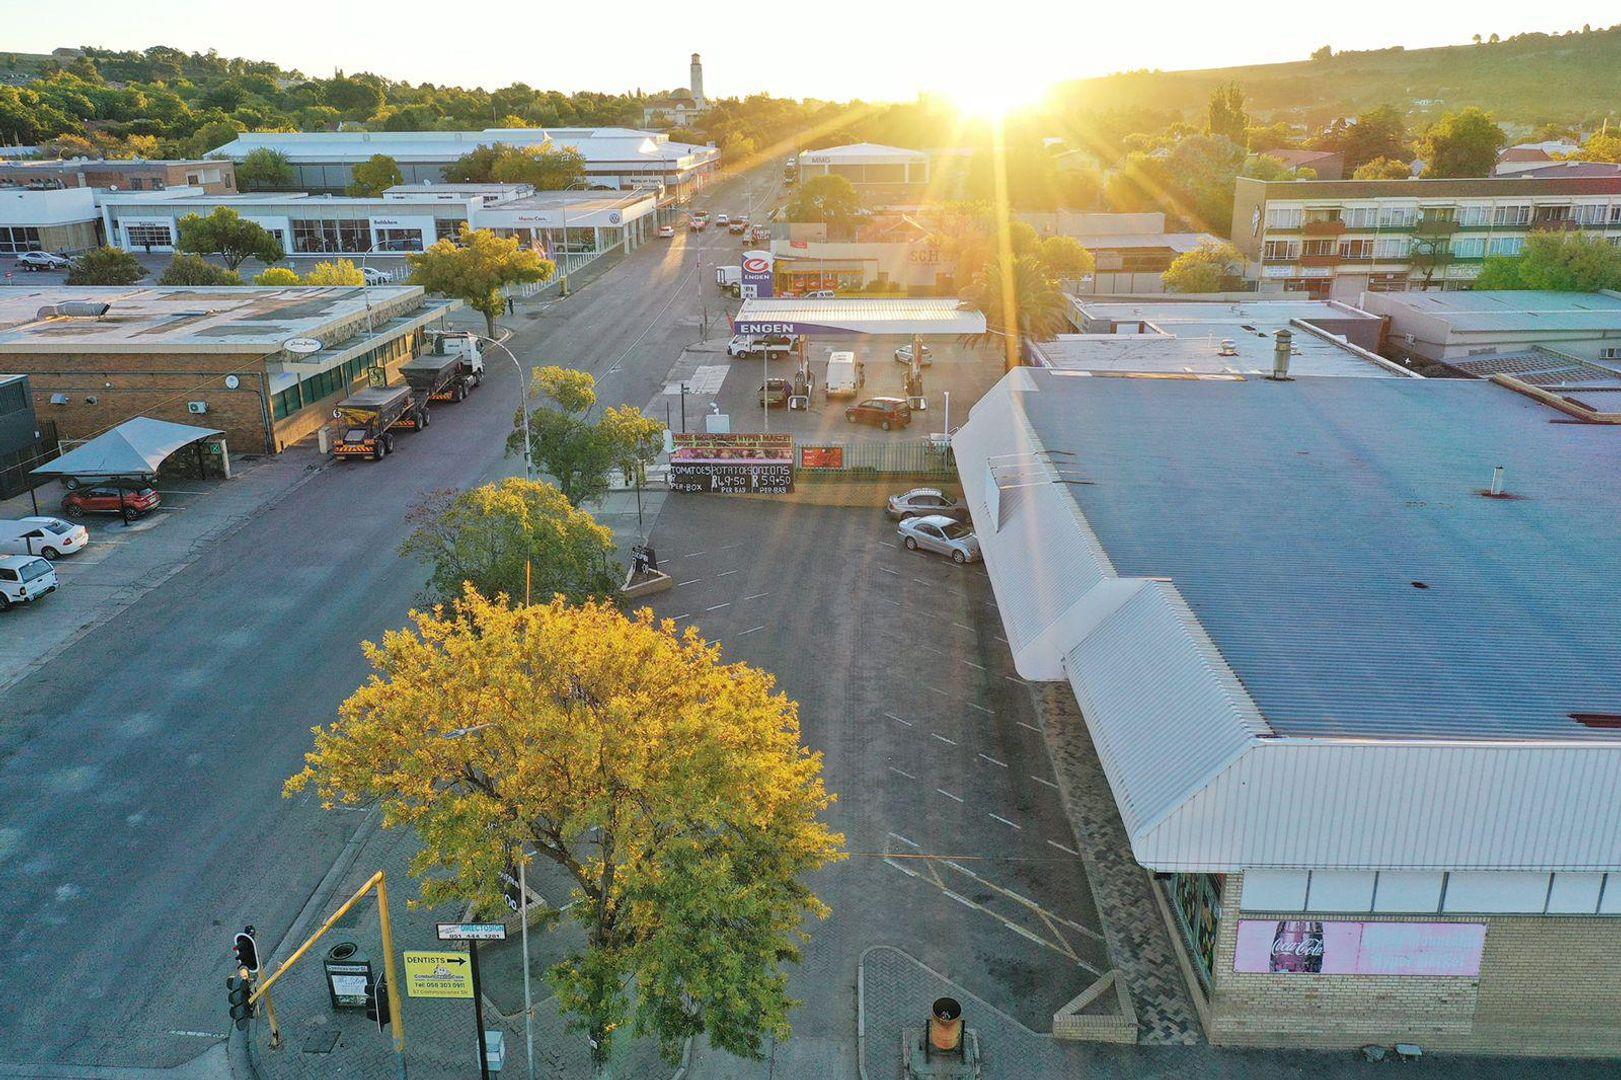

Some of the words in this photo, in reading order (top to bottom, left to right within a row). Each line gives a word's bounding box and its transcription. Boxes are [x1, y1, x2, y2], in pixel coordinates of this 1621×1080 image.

[740, 323, 794, 333] ENGEN
[670, 466, 711, 475] TOMATOES
[712, 466, 752, 475] POTATOES
[752, 466, 790, 475] ONIONS
